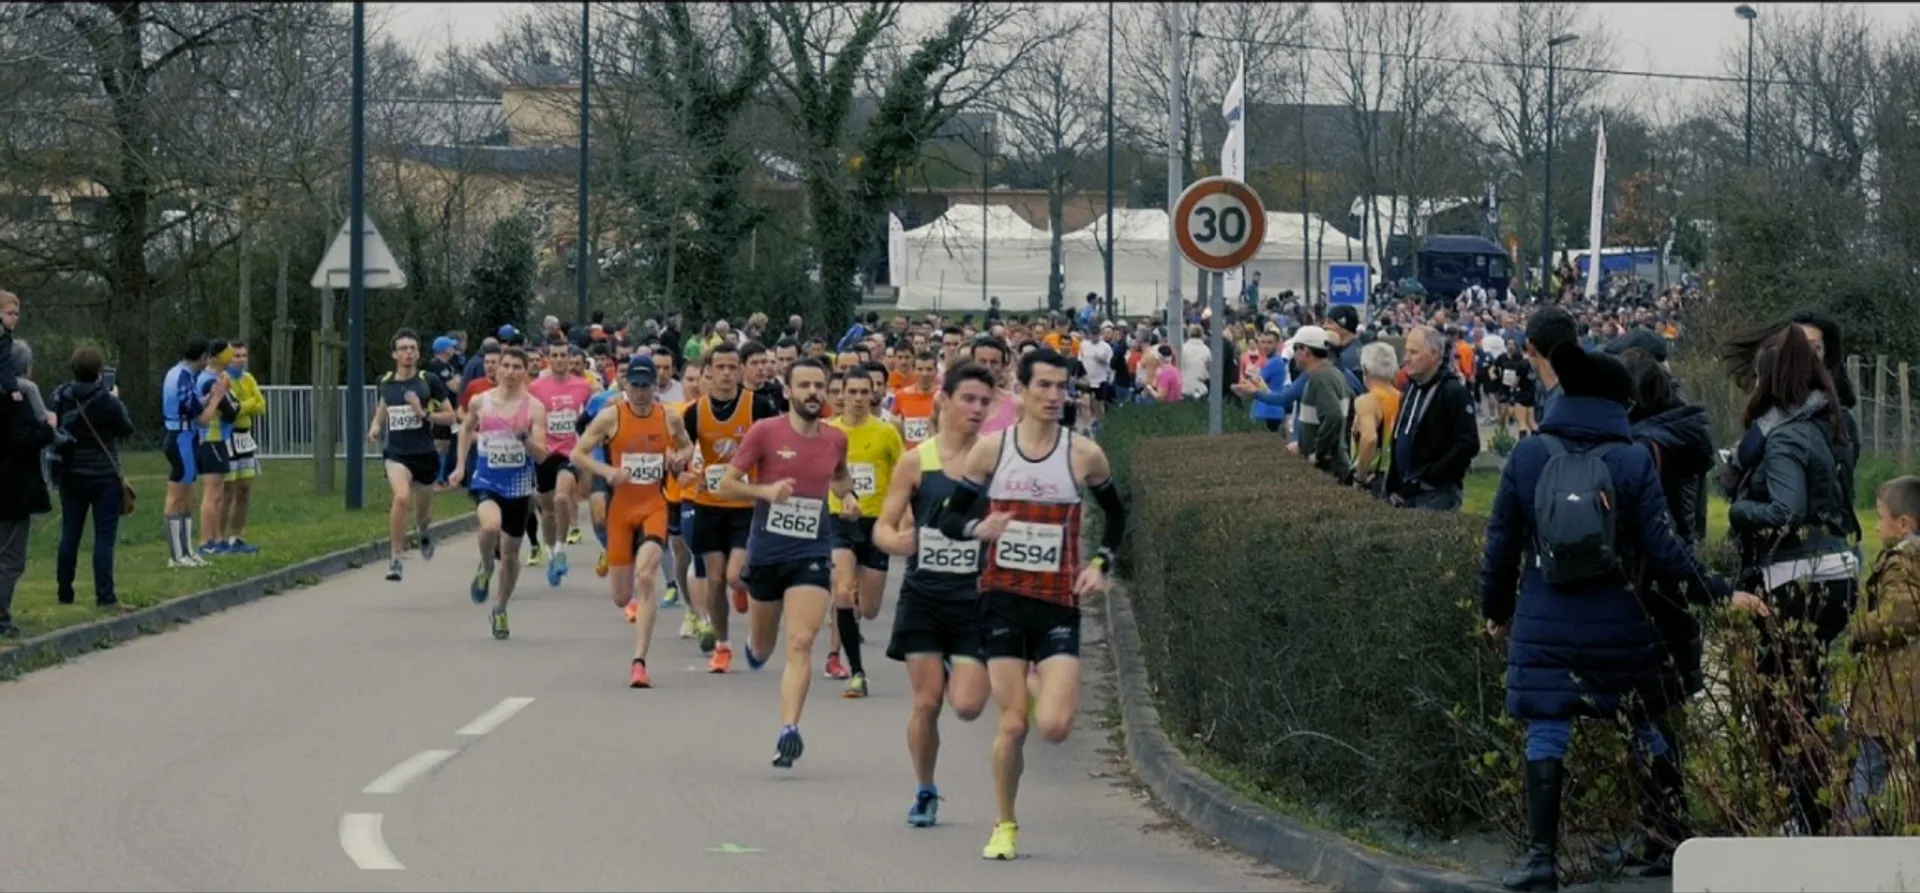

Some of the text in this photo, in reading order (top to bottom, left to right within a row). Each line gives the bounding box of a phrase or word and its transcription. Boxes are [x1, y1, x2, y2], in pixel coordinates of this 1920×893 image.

[1194, 206, 1246, 243] 30
[490, 452, 523, 464] 2430
[771, 511, 817, 533] 2662
[923, 547, 976, 566] 2629
[999, 540, 1057, 565] 2594
